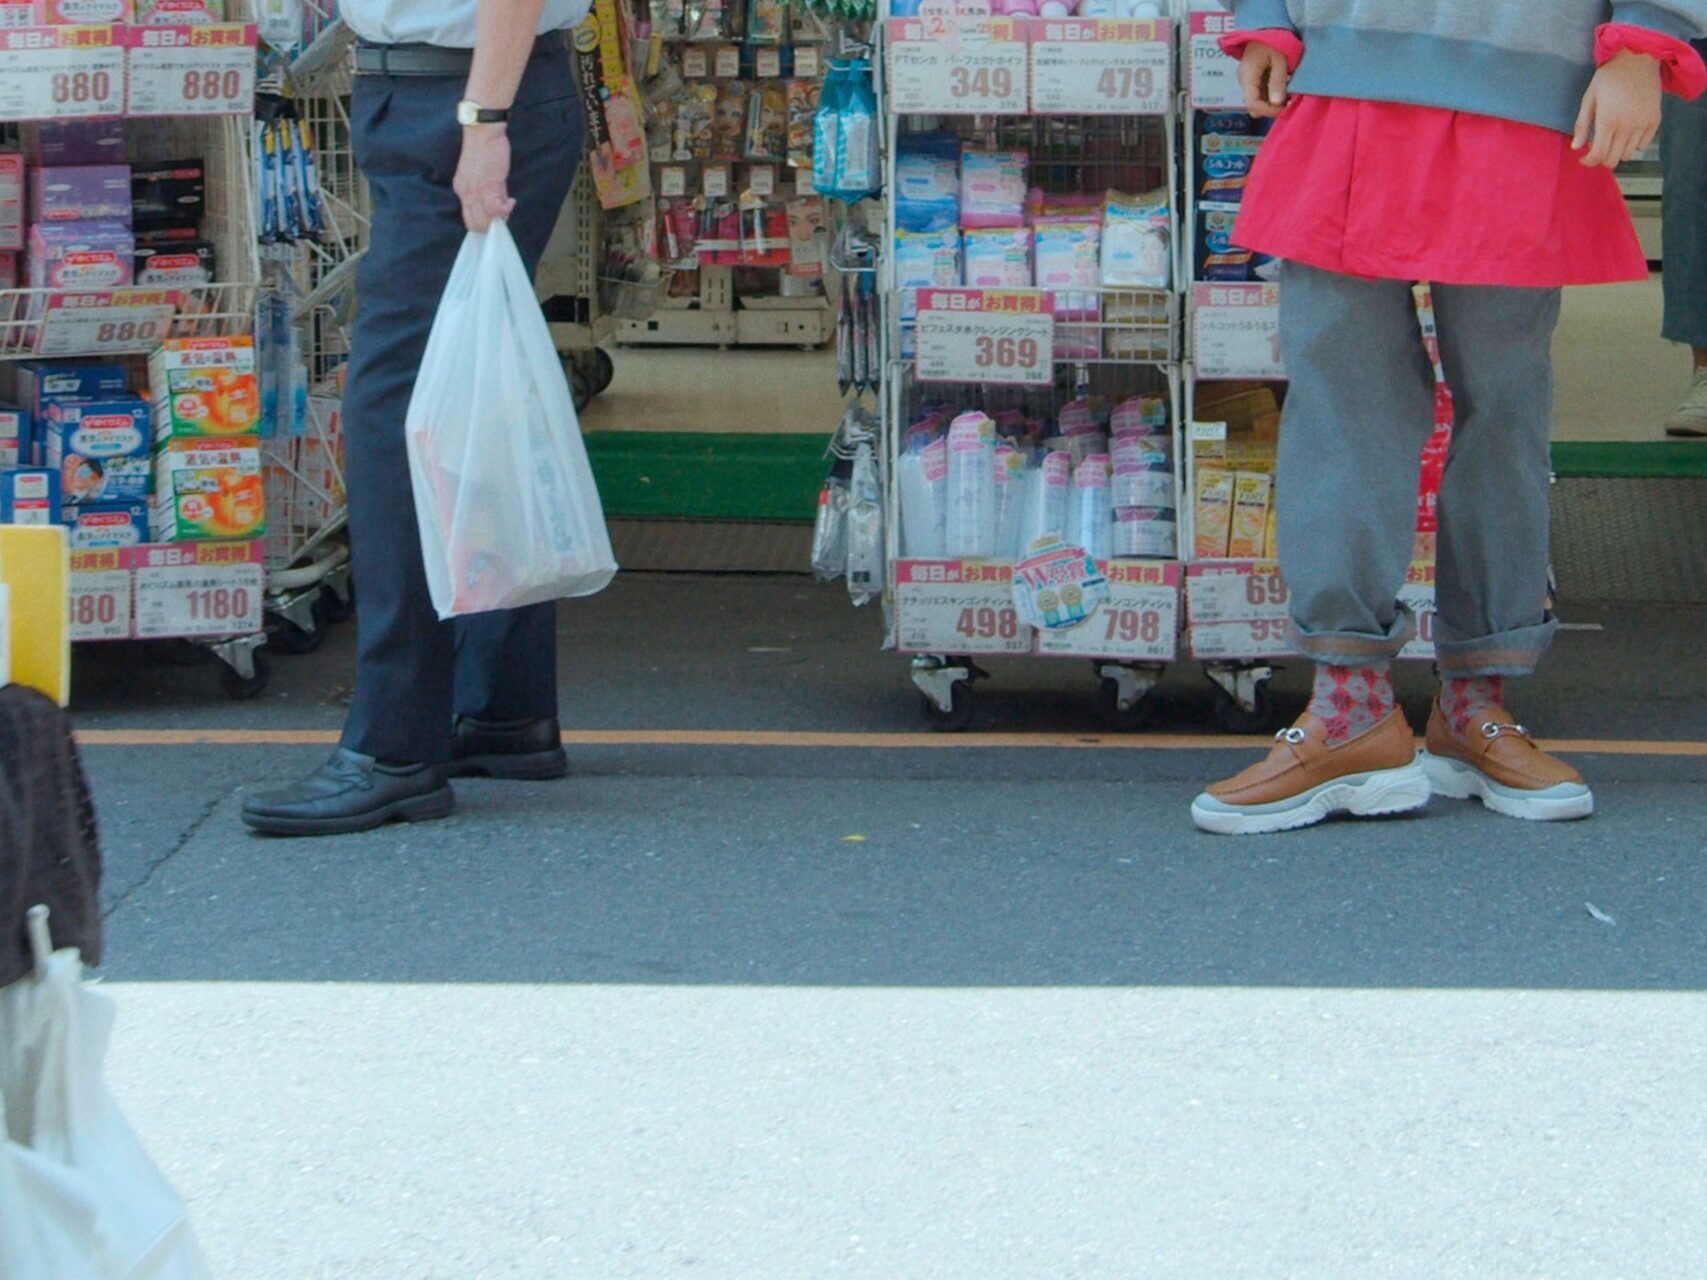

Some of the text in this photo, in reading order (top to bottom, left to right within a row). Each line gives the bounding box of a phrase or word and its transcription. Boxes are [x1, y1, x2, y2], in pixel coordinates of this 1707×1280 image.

[1045, 23, 1153, 41] 毎日がお買得
[52, 71, 110, 103] 880
[183, 70, 240, 100] 880
[951, 66, 1012, 98] 349
[1097, 66, 1154, 98] 479
[1207, 158, 1246, 170] シルコット
[930, 292, 1037, 312] 毎日がお買得
[97, 321, 157, 342] 880
[975, 336, 1038, 368] 369
[187, 588, 249, 620] 1180
[1246, 575, 1288, 605] 69
[70, 593, 116, 625] 80
[956, 607, 1018, 639] 498
[1103, 609, 1161, 642] 798
